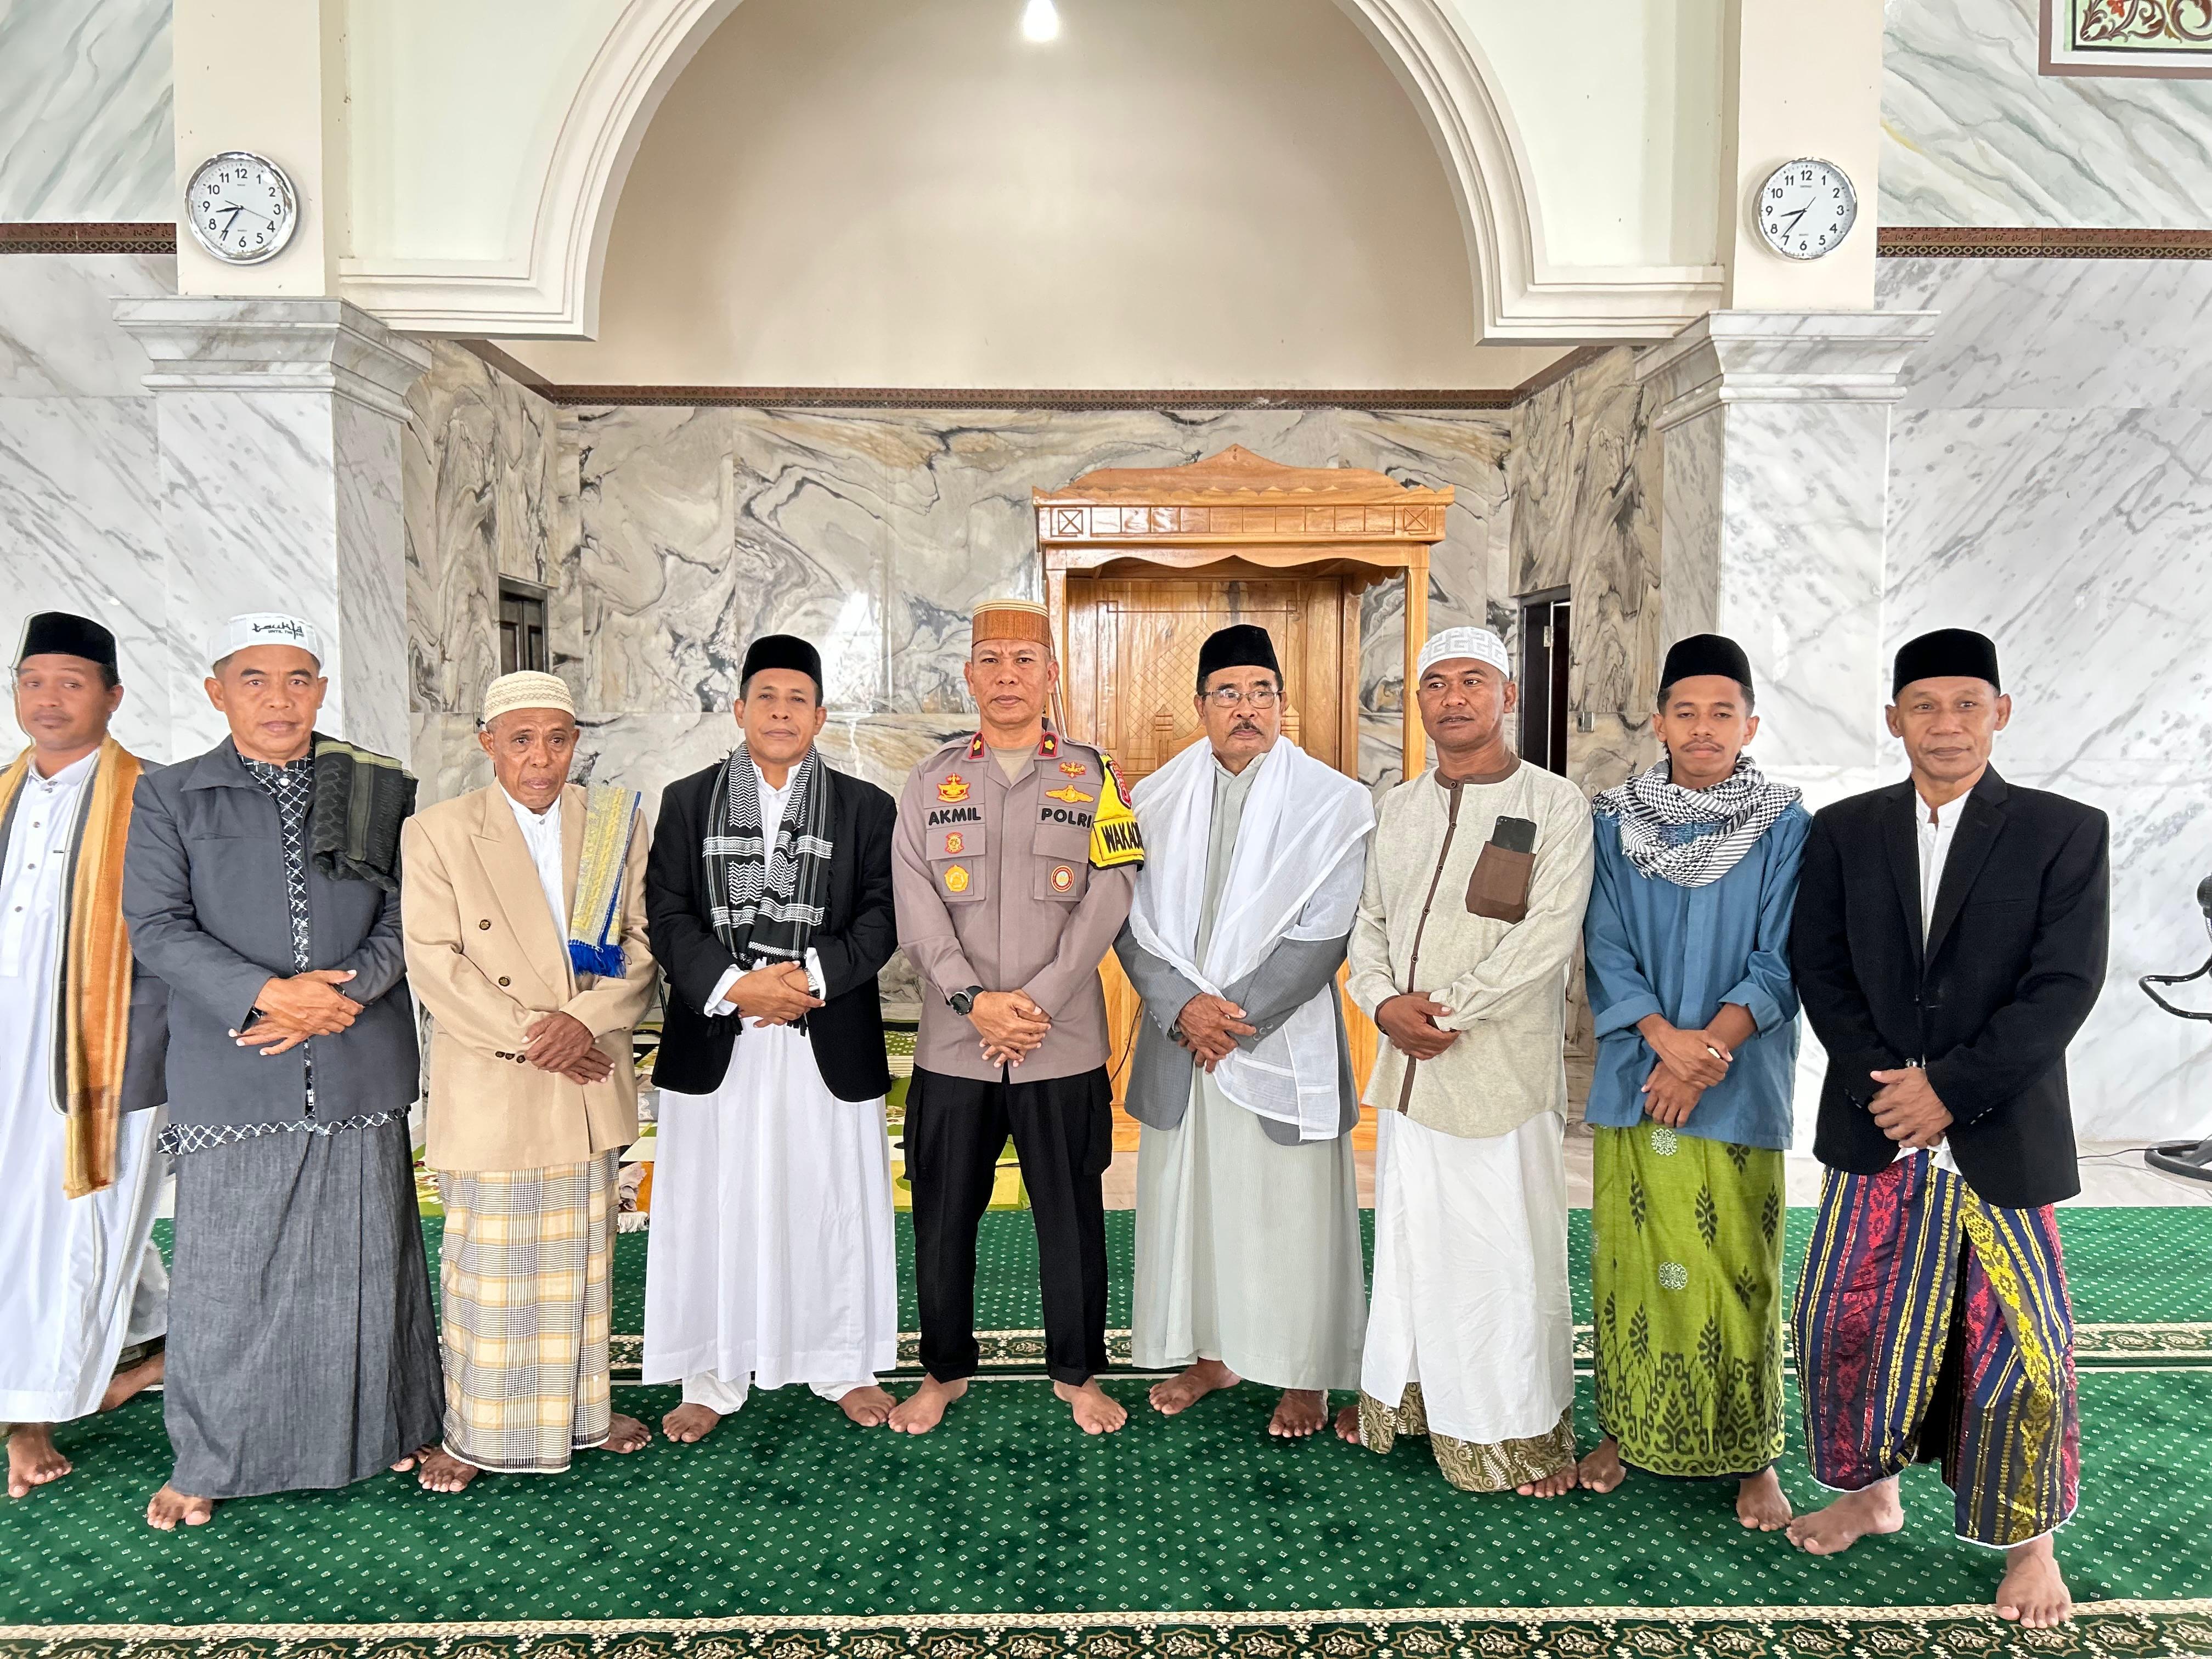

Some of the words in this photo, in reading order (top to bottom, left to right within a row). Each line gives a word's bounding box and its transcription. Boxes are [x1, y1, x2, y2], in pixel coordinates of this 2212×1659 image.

[219, 173, 229, 183] 11
[235, 168, 247, 179] 12
[256, 174, 261, 184] 1
[1801, 170, 1813, 180] 12
[1785, 175, 1794, 185] 11
[1821, 175, 1826, 185] 1
[207, 184, 220, 194] 10
[268, 187, 275, 197] 2
[1771, 188, 1783, 198] 10
[1832, 188, 1839, 198] 2
[202, 201, 210, 212] 9
[273, 204, 281, 215] 3
[1765, 206, 1773, 216] 9
[1836, 205, 1844, 216] 3
[208, 218, 216, 230] 8
[267, 221, 275, 233] 4
[1770, 223, 1778, 234] 8
[1829, 223, 1837, 234] 4
[222, 230, 228, 241] 7
[256, 233, 263, 244] 5
[1783, 235, 1790, 245] 7
[1819, 235, 1826, 245] 5
[239, 236, 246, 247] 6
[1799, 240, 1807, 251] 6
[928, 807, 981, 826] AKMIL
[1041, 808, 1092, 828] POLRI
